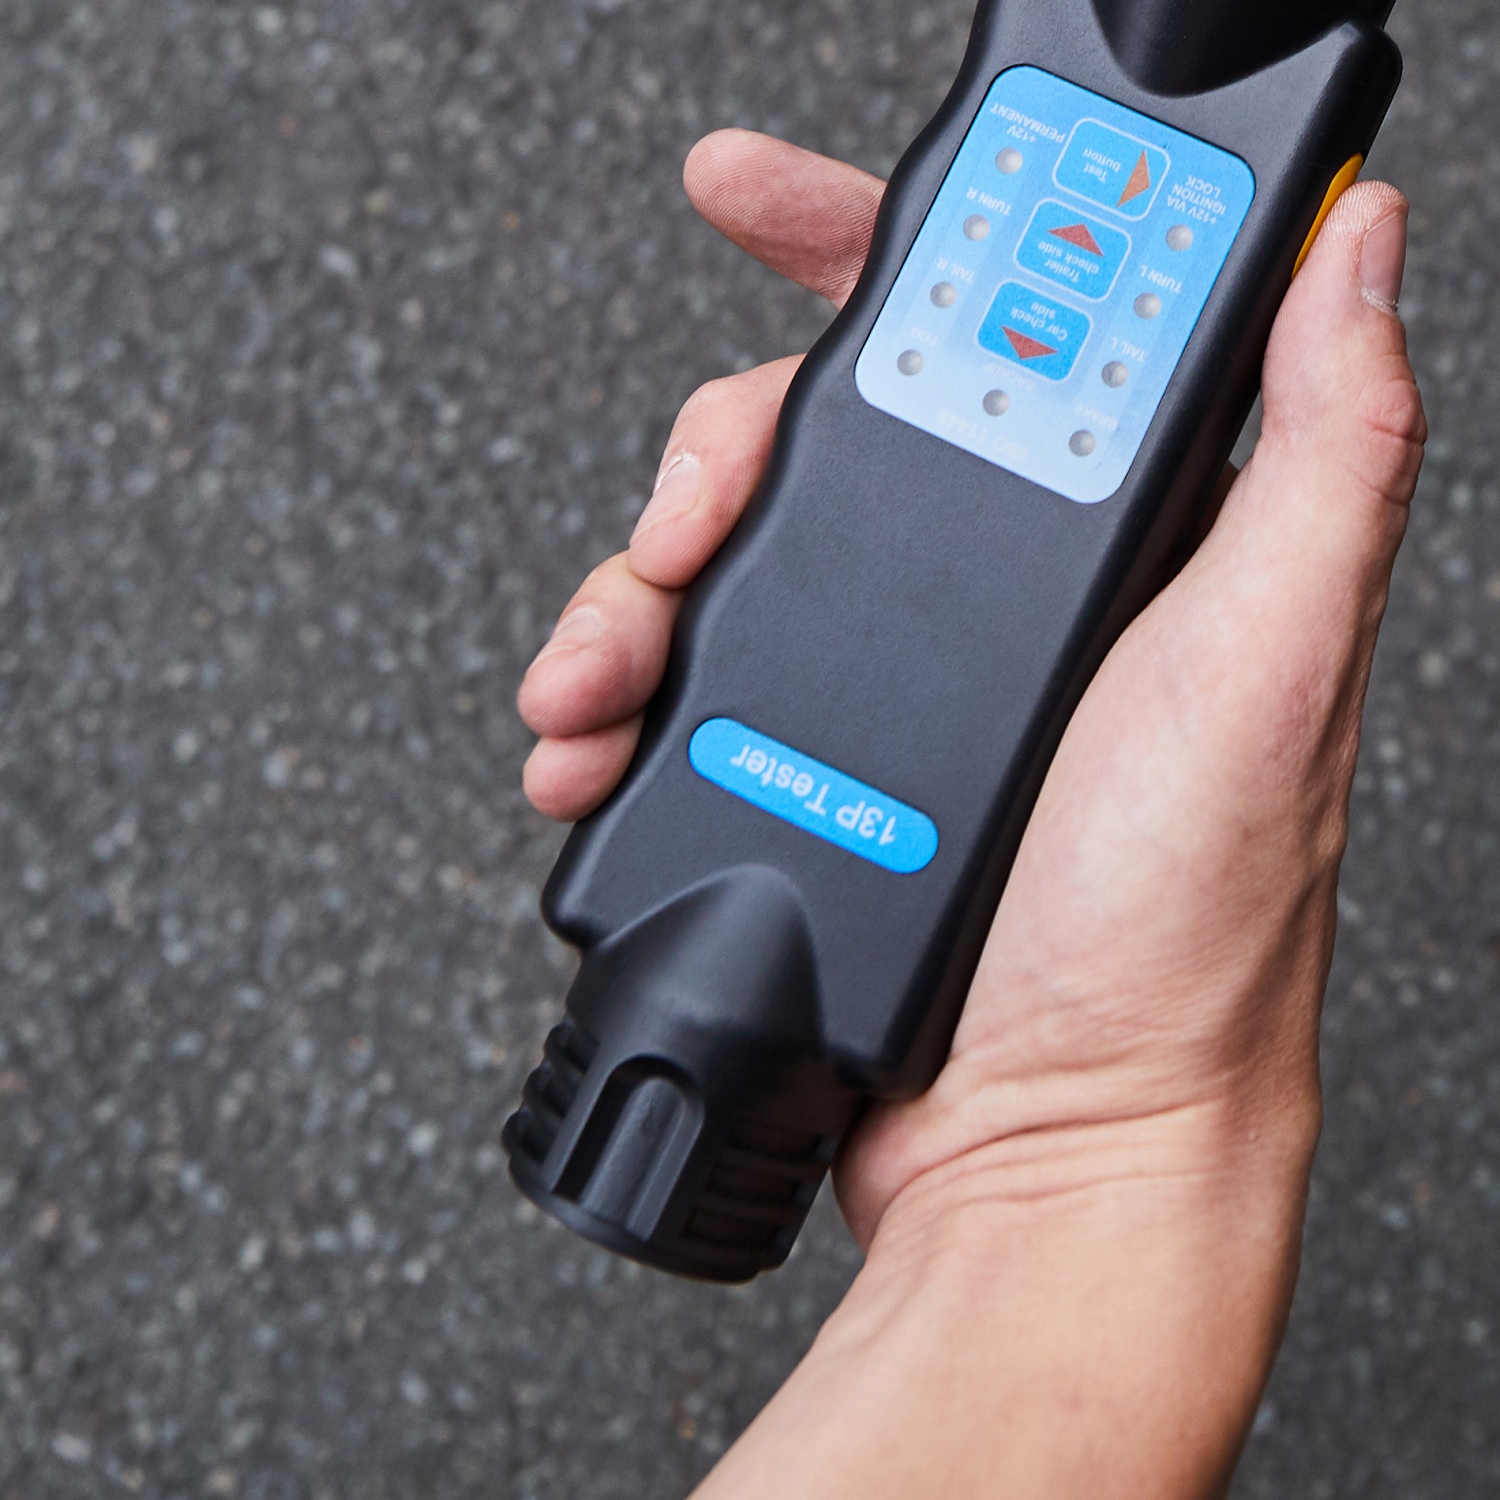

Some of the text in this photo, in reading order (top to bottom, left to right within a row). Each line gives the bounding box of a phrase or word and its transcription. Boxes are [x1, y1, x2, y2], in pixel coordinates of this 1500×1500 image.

[990, 100, 1066, 143] PERMANENT
[1081, 146, 1122, 173] button
[1082, 161, 1109, 182] Test
[965, 185, 1013, 215] TURN R
[1171, 181, 1227, 215] IGNITION
[1184, 174, 1221, 199] LOCK
[1036, 239, 1100, 276] check side
[1042, 257, 1081, 283] Trailer
[946, 262, 976, 283] TAIL
[1136, 264, 1183, 293] TURN L
[1008, 305, 1069, 342] Car check
[1028, 300, 1056, 321] side
[1117, 340, 1147, 362] TAIL
[730, 745, 899, 846] 13P Tester
